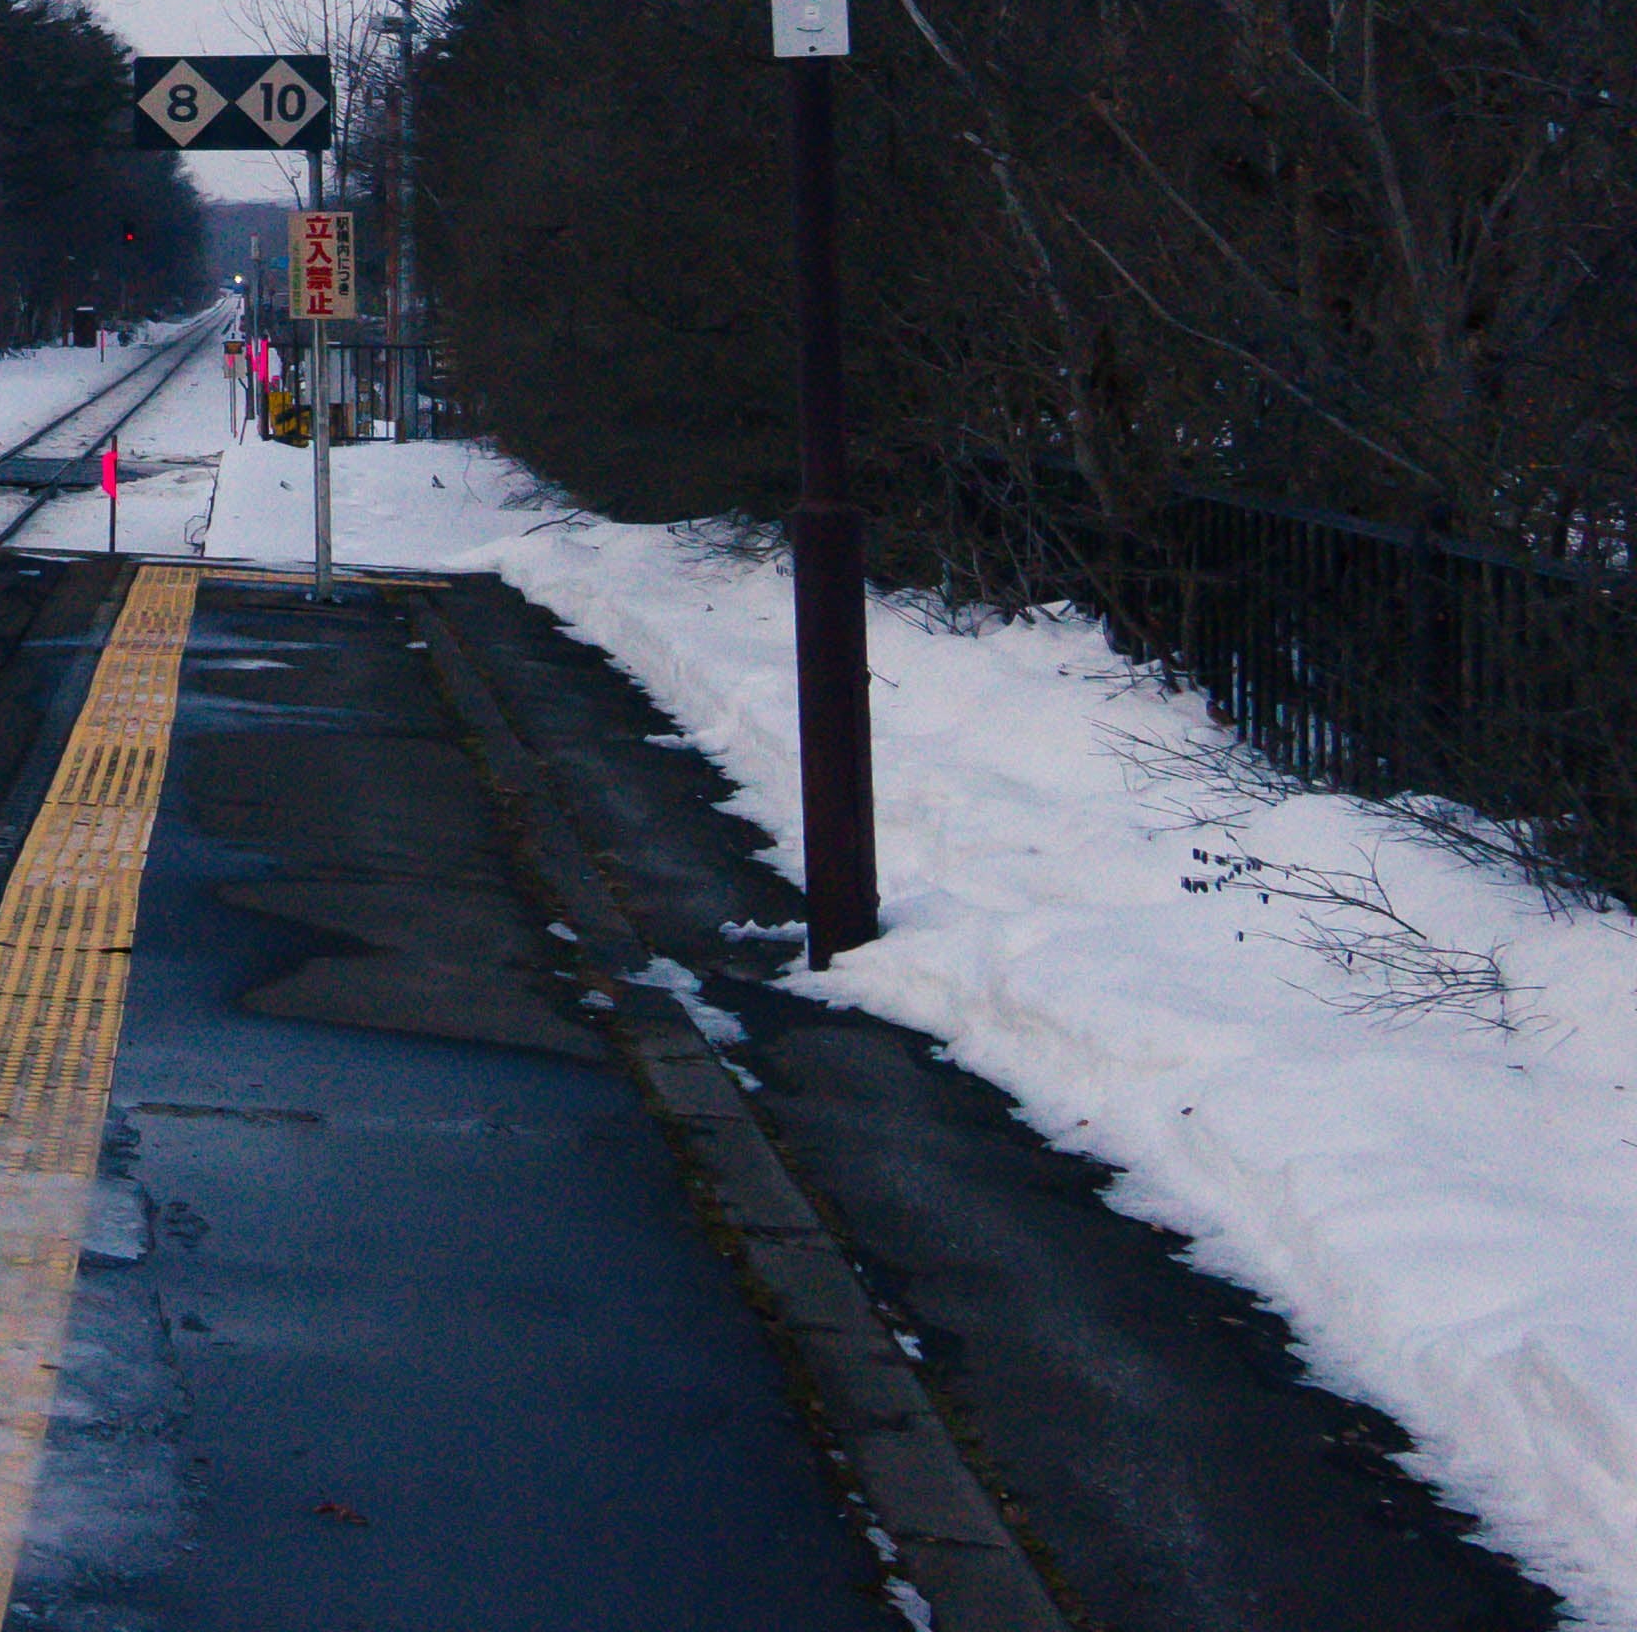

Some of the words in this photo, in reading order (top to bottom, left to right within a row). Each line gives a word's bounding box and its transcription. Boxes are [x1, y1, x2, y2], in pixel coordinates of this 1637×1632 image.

[167, 84, 199, 123] 8
[260, 83, 307, 123] 10
[306, 216, 333, 315] 立入禁止
